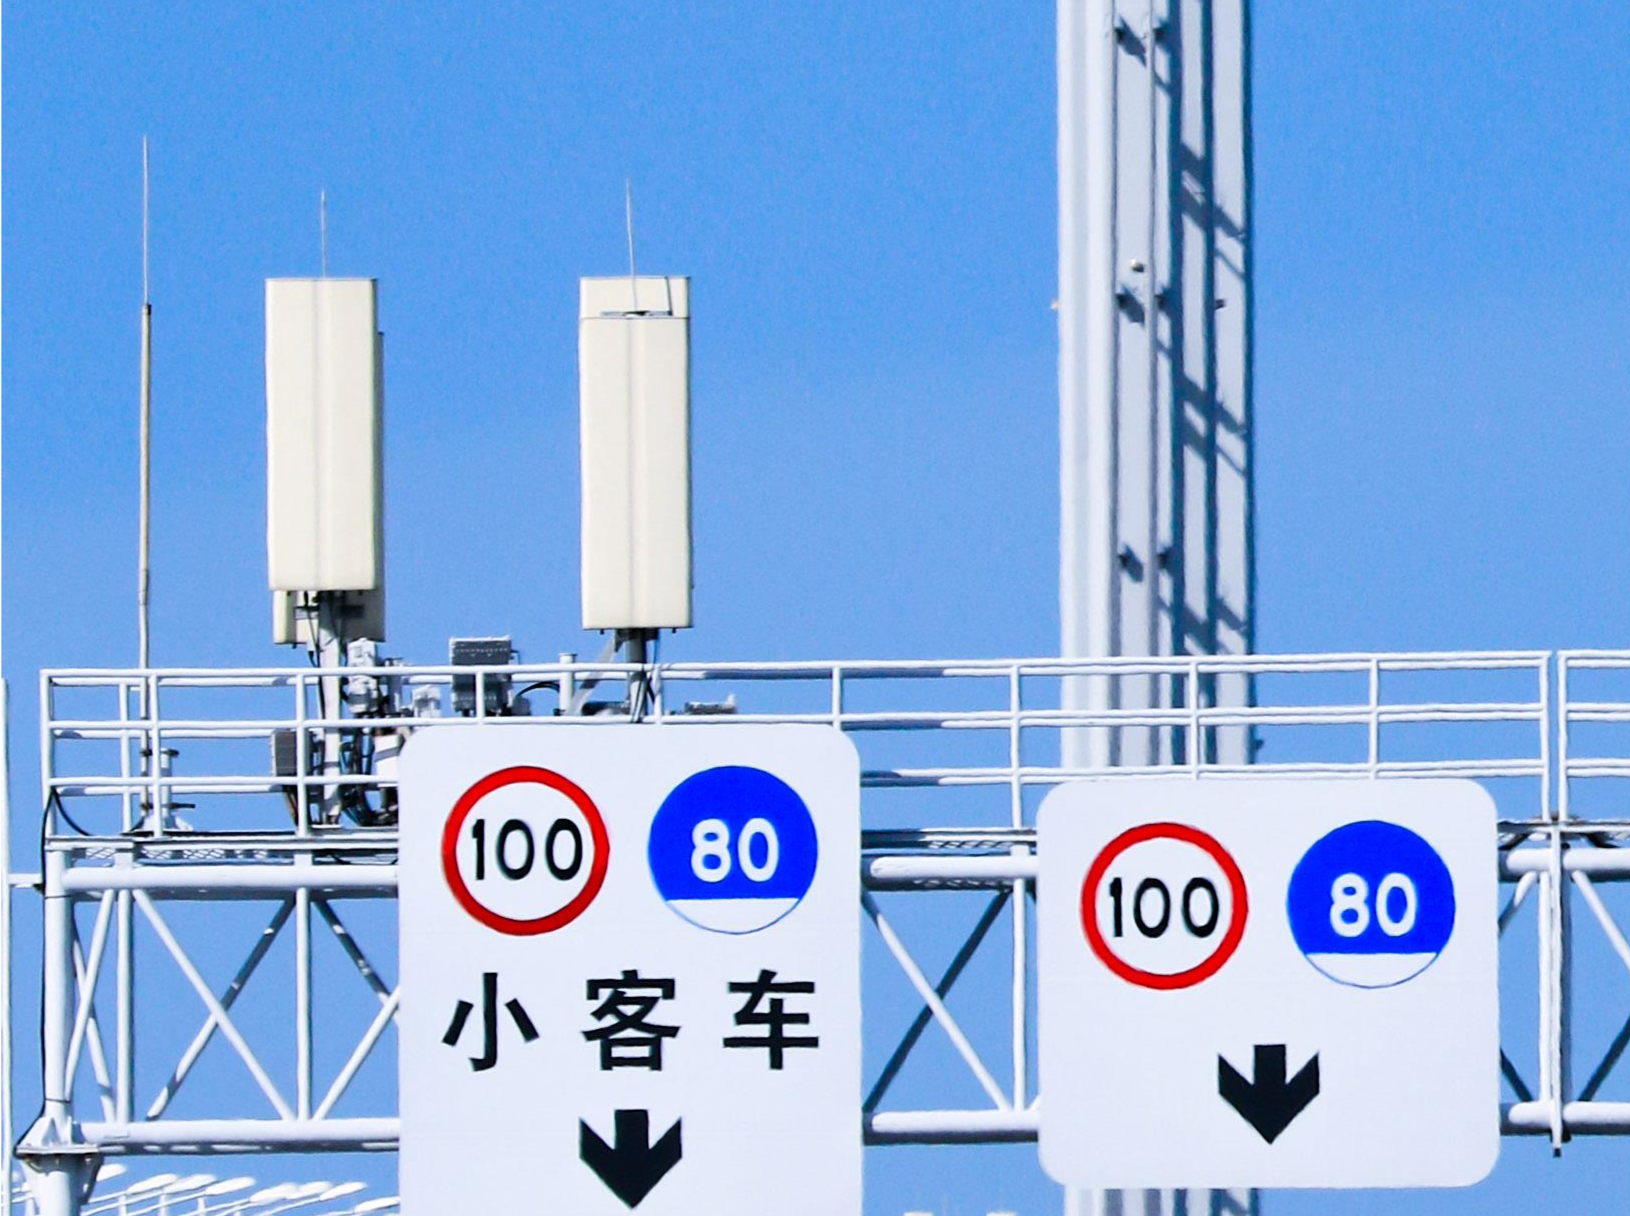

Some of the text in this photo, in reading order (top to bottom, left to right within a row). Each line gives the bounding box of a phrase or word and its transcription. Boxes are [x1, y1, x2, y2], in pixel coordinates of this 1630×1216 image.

[472, 819, 584, 881] 100
[691, 818, 779, 883] 80
[1109, 877, 1220, 938] 100
[1330, 872, 1417, 938] 80
[442, 970, 820, 1072] 小客车
